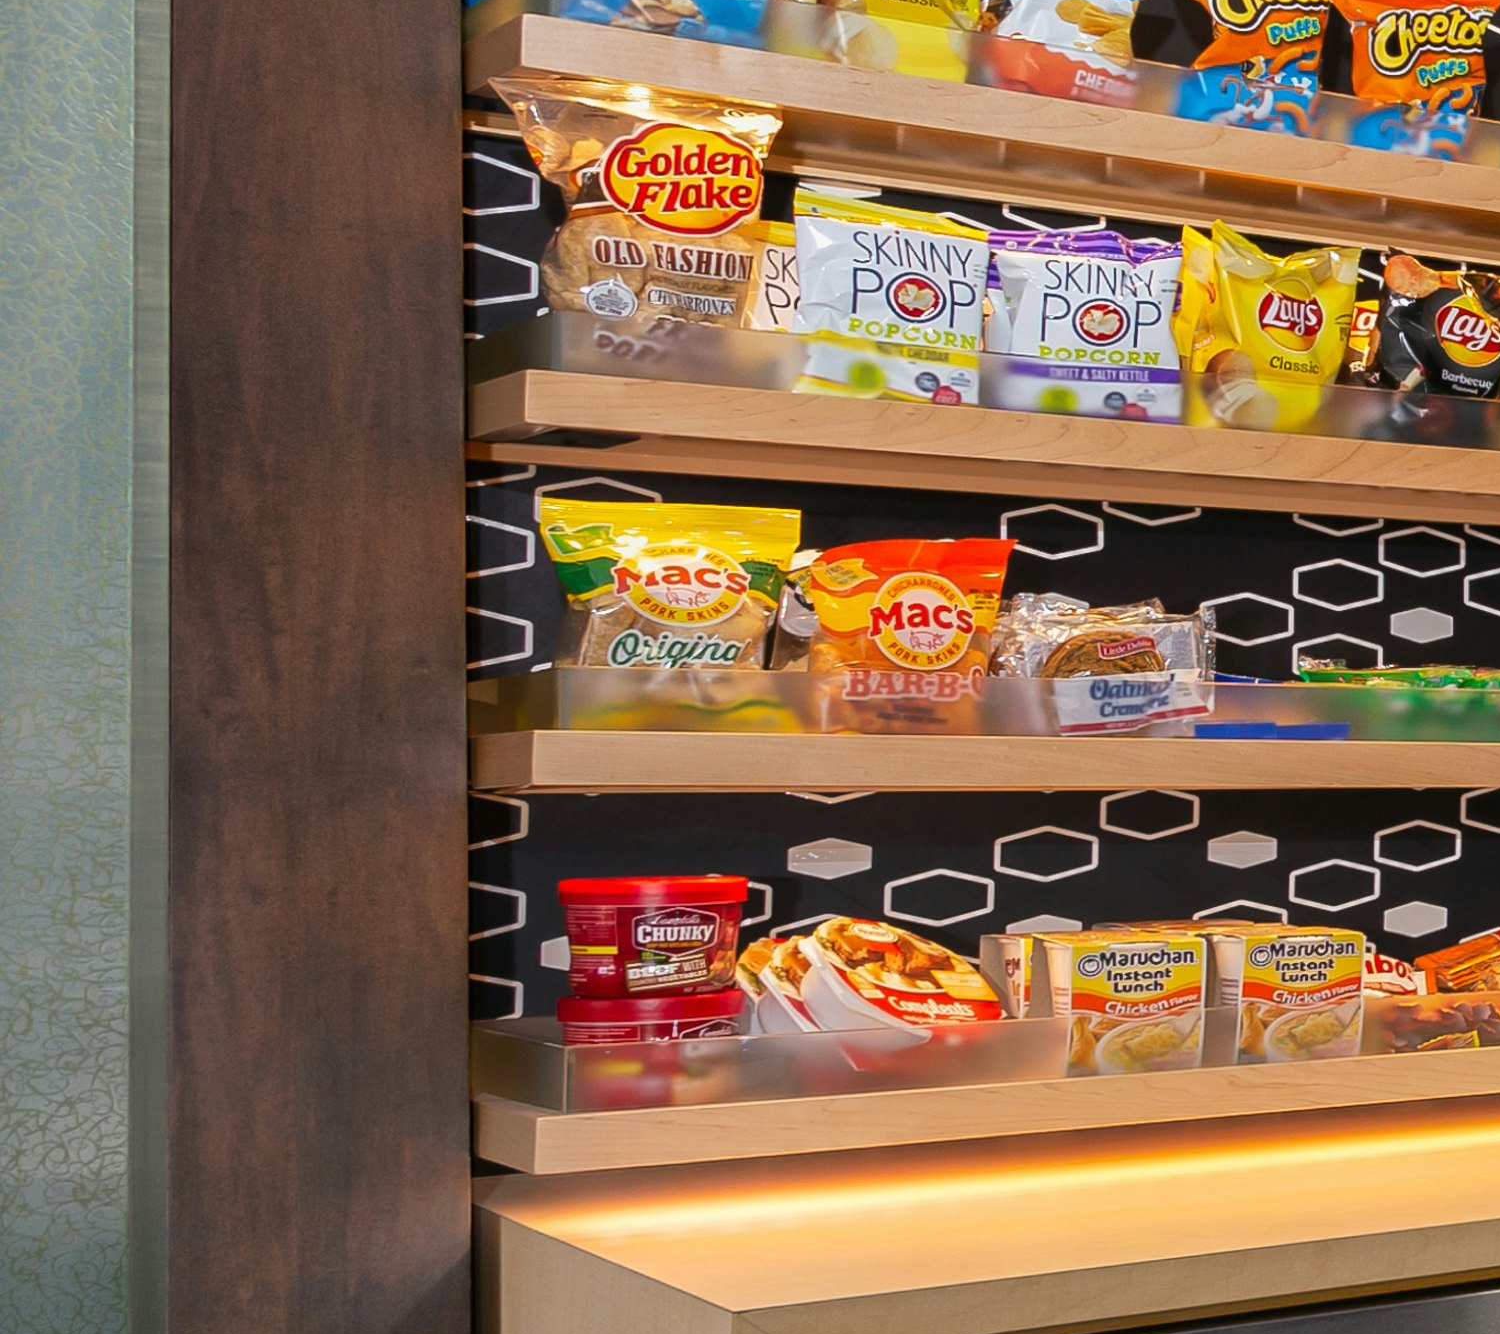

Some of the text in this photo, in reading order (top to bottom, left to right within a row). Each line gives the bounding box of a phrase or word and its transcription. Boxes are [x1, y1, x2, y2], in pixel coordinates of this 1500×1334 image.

[616, 143, 755, 180] Golden
[627, 177, 753, 214] Flake
[594, 238, 644, 267] OLD
[851, 267, 976, 329] POP
[1041, 293, 1161, 349] POP
[1262, 295, 1318, 337] Lay's
[847, 317, 977, 351] POPCORN
[1038, 345, 1161, 366] POPCORN
[1269, 355, 1320, 375] Classic
[1119, 370, 1150, 383] KETTLE
[614, 564, 749, 596] Mac's
[639, 597, 730, 622] PORK SKINS
[870, 600, 973, 637] Mac's
[887, 641, 961, 665] PORK SKINS
[1103, 643, 1126, 656] Little
[637, 924, 715, 944] CHUNKY
[1099, 948, 1197, 968] Maruchan
[1269, 941, 1357, 959] Maruchan
[1106, 968, 1172, 983] Instant
[1274, 959, 1335, 973] Instant
[1279, 969, 1327, 984] Lunch
[1113, 981, 1165, 995] Lunch
[1272, 983, 1358, 1005] Chicken Flavor
[887, 995, 976, 1018] Compleats
[1104, 993, 1199, 1017] Chicken Flavor
